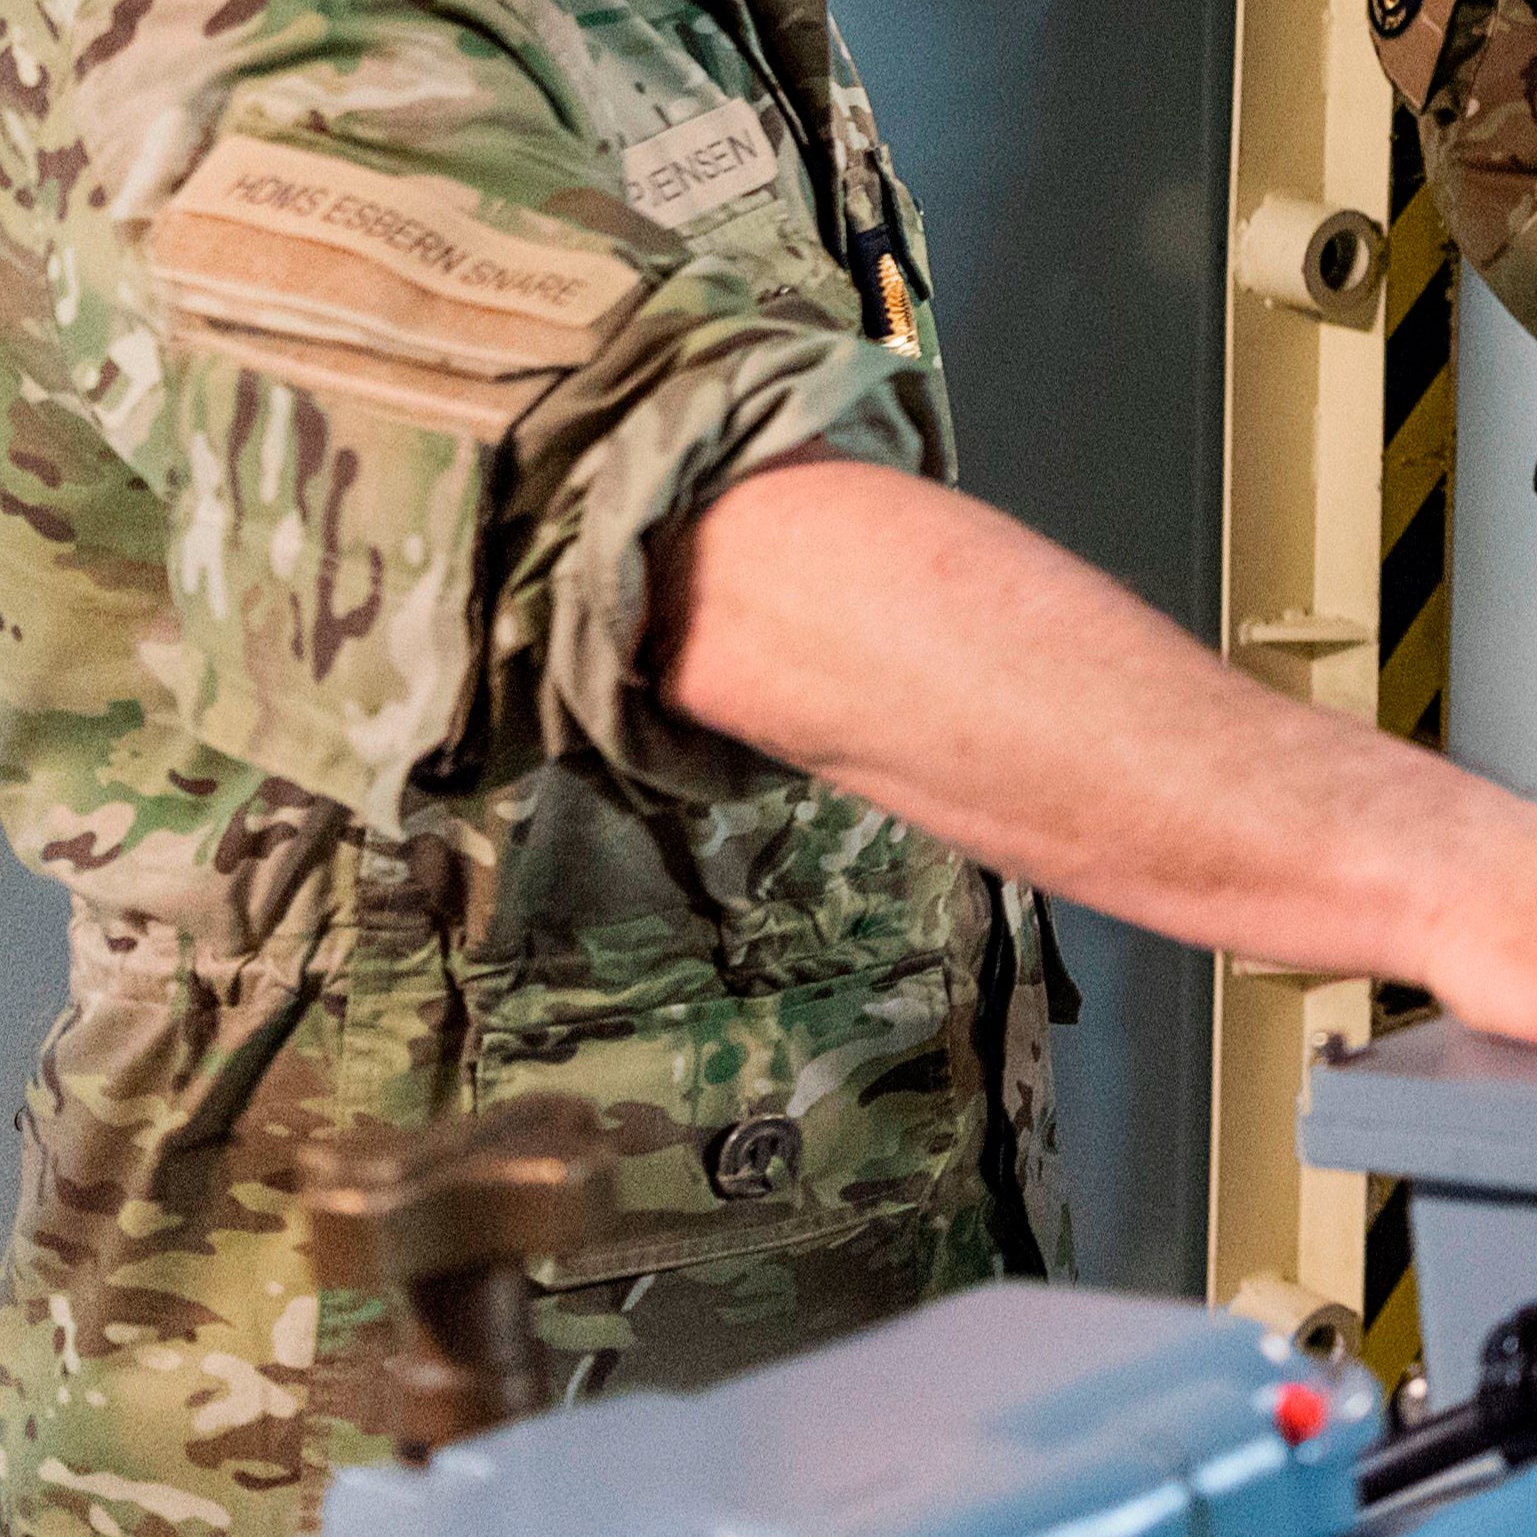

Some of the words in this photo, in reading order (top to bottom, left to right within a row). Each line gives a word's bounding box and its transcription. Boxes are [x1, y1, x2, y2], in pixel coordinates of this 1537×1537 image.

[224, 173, 328, 217] HDMS
[321, 194, 472, 275] ESBERN
[460, 262, 589, 307] SNARE
